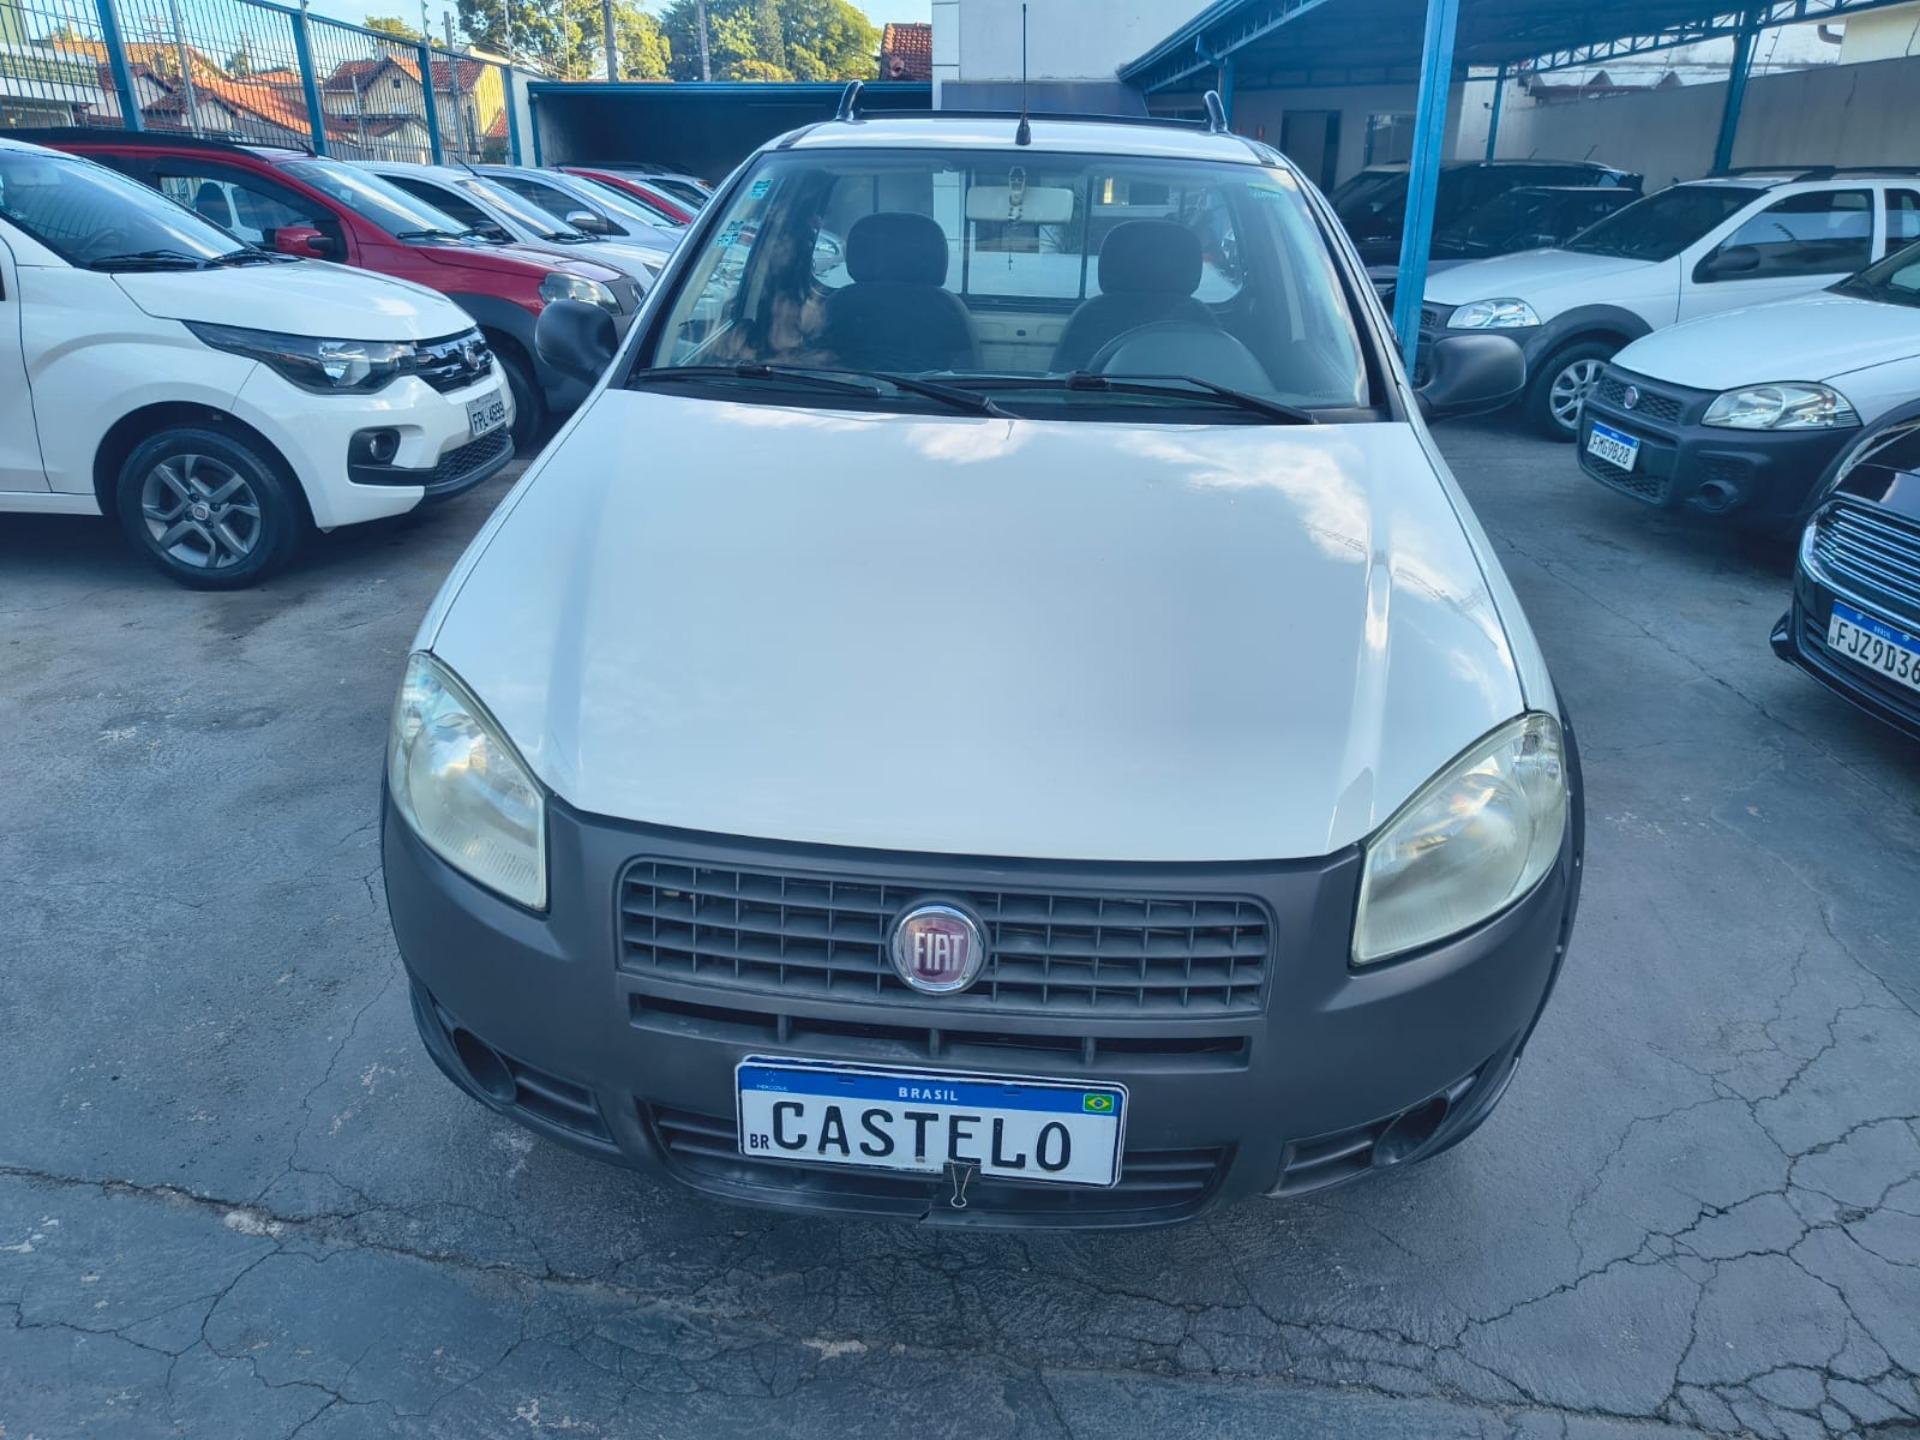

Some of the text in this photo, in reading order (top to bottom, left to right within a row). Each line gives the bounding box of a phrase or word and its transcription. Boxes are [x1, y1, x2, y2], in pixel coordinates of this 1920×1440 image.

[1836, 622, 1920, 685] FJZ9D36
[914, 932, 964, 970] FIAT
[898, 1086, 959, 1101] BRASIL
[750, 1133, 769, 1150] BR
[773, 1101, 1071, 1171] CASTELO
